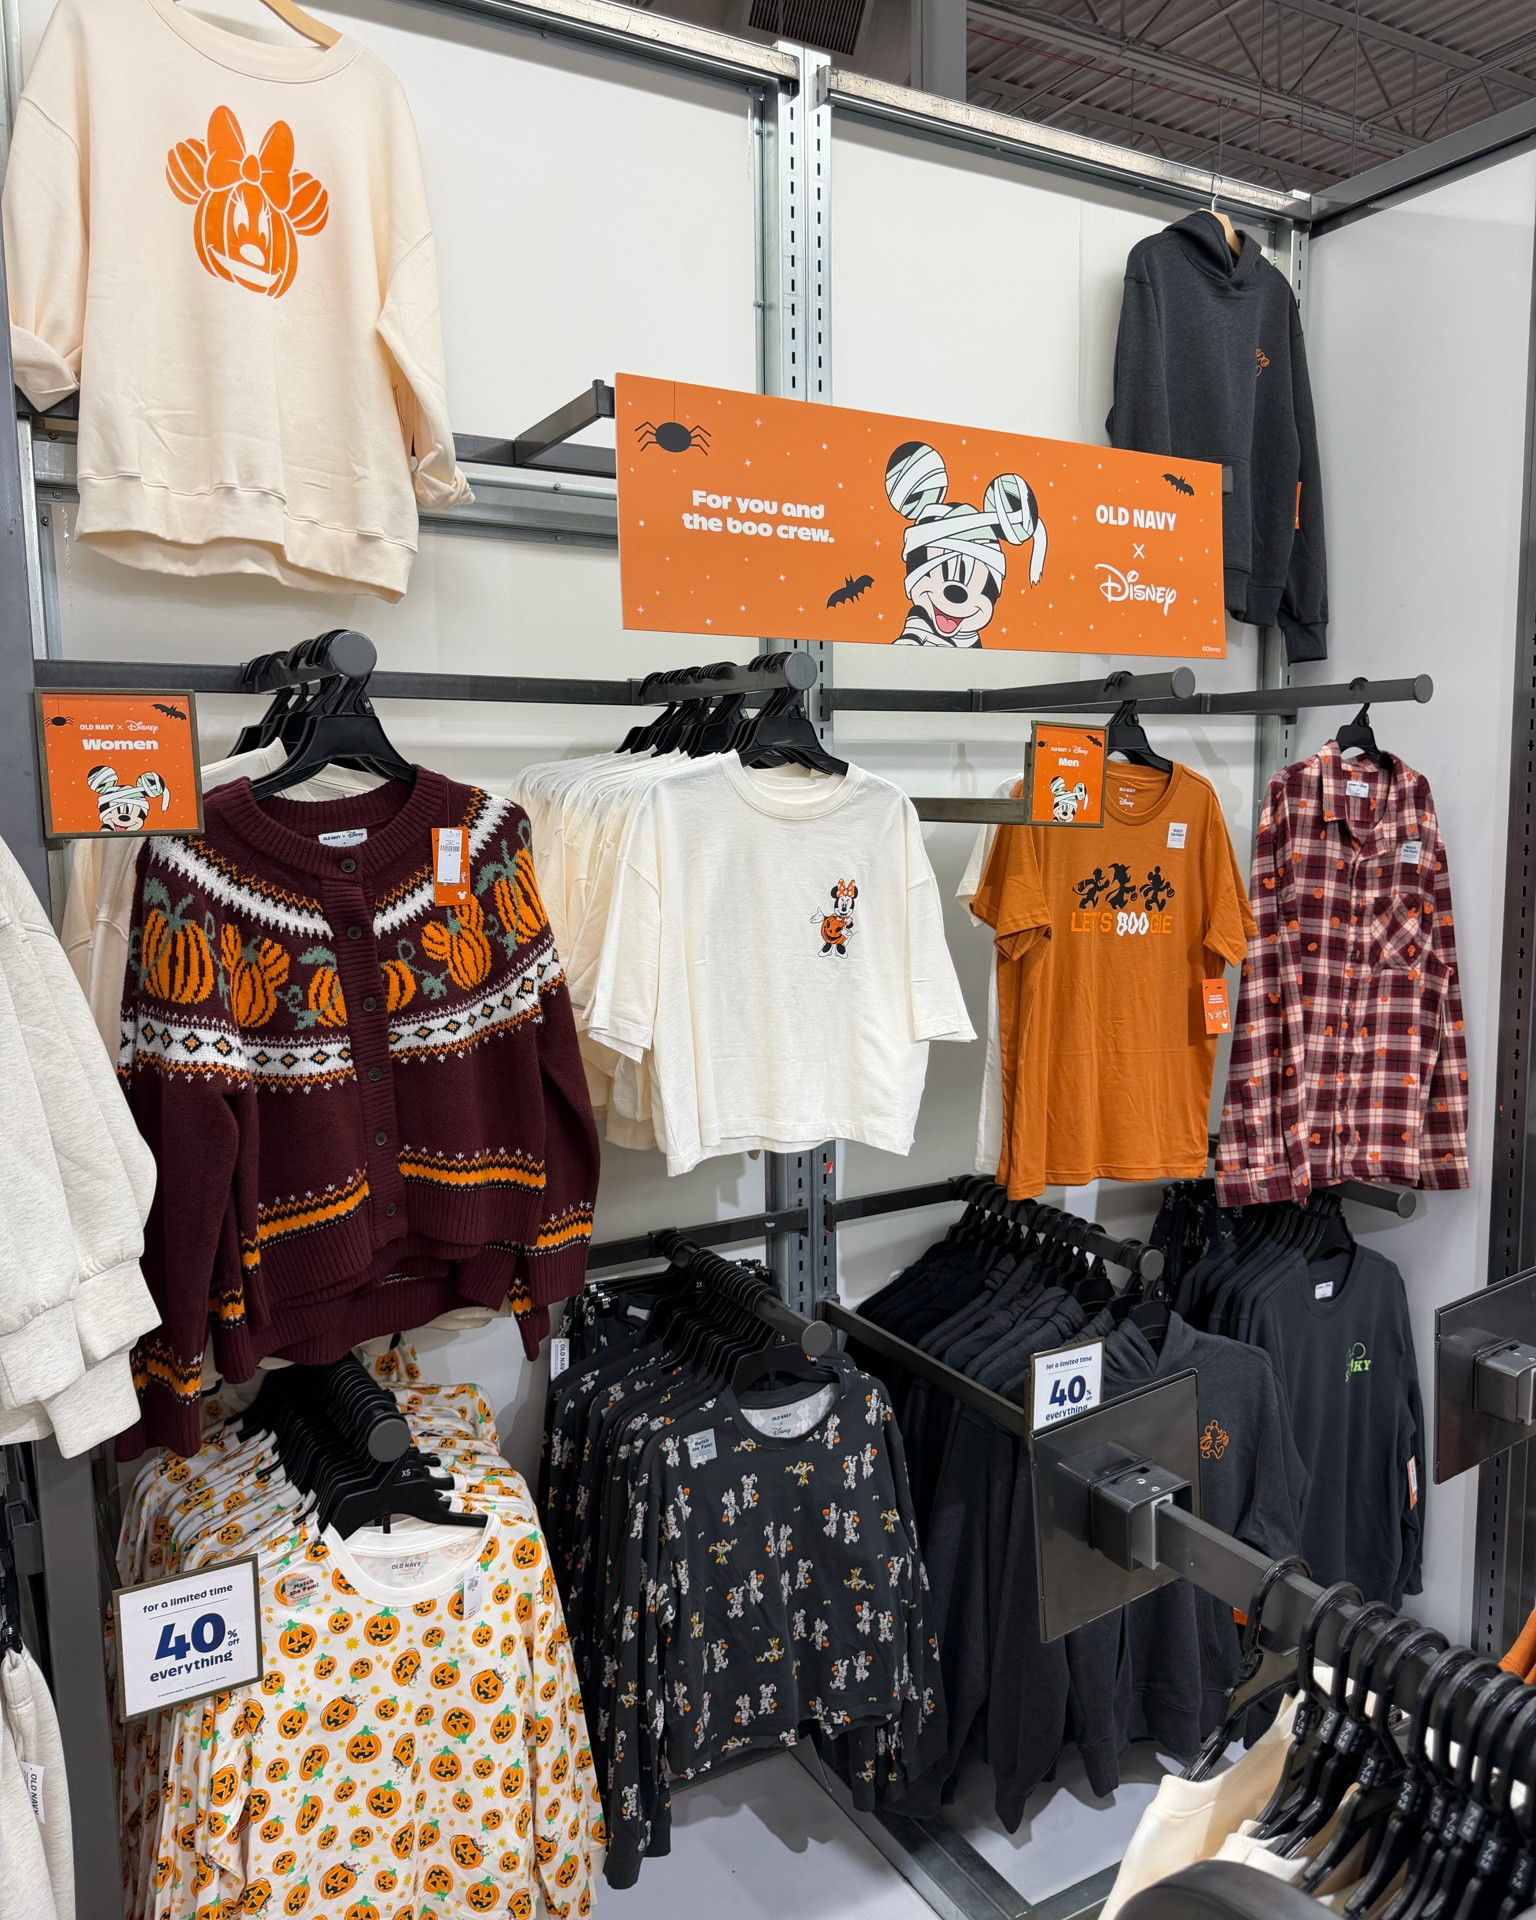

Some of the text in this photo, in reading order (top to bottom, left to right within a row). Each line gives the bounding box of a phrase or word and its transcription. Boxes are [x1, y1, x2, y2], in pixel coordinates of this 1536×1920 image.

[692, 490, 825, 520] For you and
[1095, 504, 1177, 531] OLD NAVY
[682, 512, 835, 543] the boo crew.
[82, 739, 159, 750] Women
[1058, 757, 1080, 768] Men
[1070, 911, 1174, 937] LET'S BOOGIE
[1059, 1358, 1079, 1367] limited
[1079, 1356, 1092, 1364] time
[1048, 1374, 1086, 1407] 40
[391, 1560, 422, 1570] OLD NAVY
[293, 1579, 314, 1589] Match
[142, 1584, 233, 1613] for a limited time
[154, 1612, 226, 1661] 40
[227, 1637, 240, 1647] off
[149, 1650, 233, 1683] everything
[30, 1773, 40, 1816] OLD NAVY
